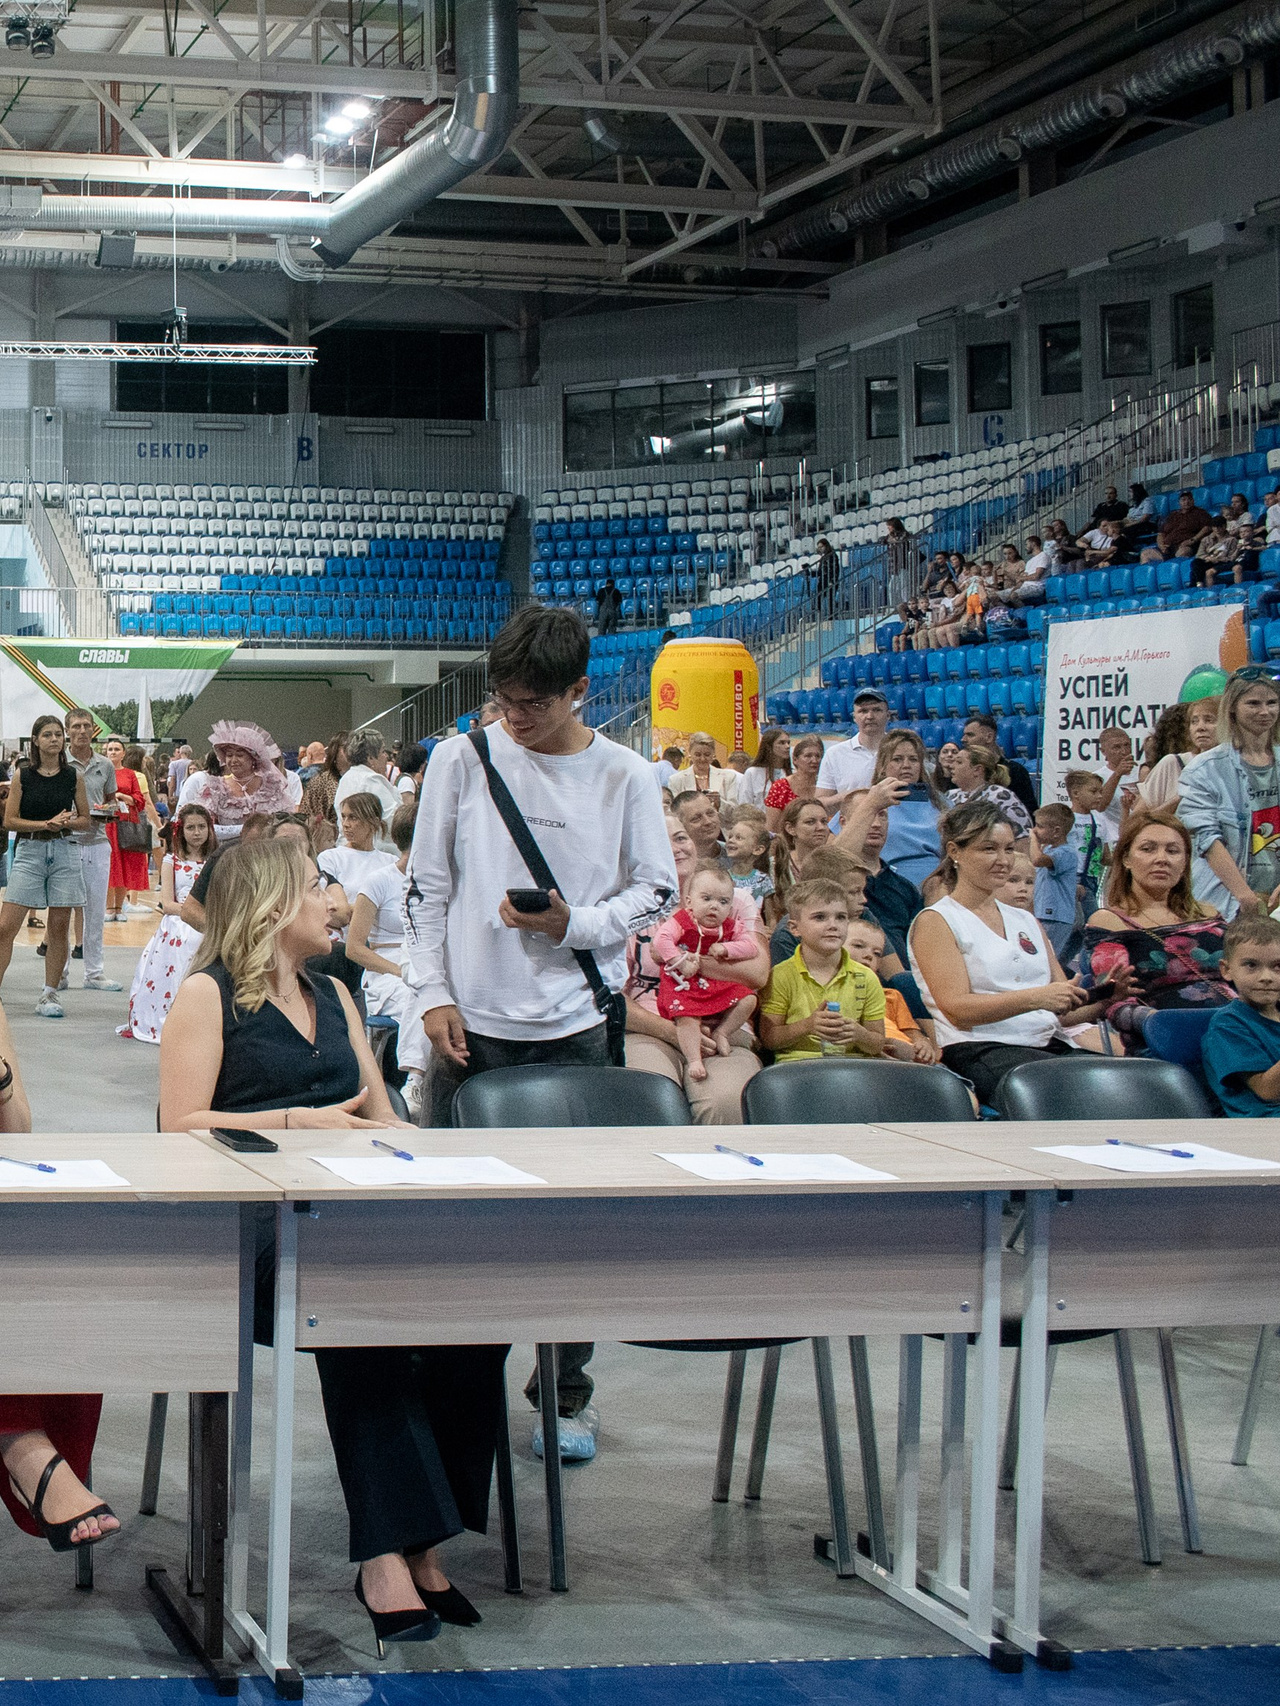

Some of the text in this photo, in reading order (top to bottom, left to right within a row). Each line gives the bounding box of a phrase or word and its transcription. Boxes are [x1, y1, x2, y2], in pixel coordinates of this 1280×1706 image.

[137, 442, 209, 459] СЕКТОР
[78, 649, 130, 664] славы
[1059, 653, 1076, 669] Дом
[1078, 653, 1112, 669] Культуры
[1059, 667, 1129, 700] УСПЕЙ
[734, 683, 743, 751] НСКПИВО
[1058, 739, 1071, 761] В
[1056, 793, 1072, 802] Теа
